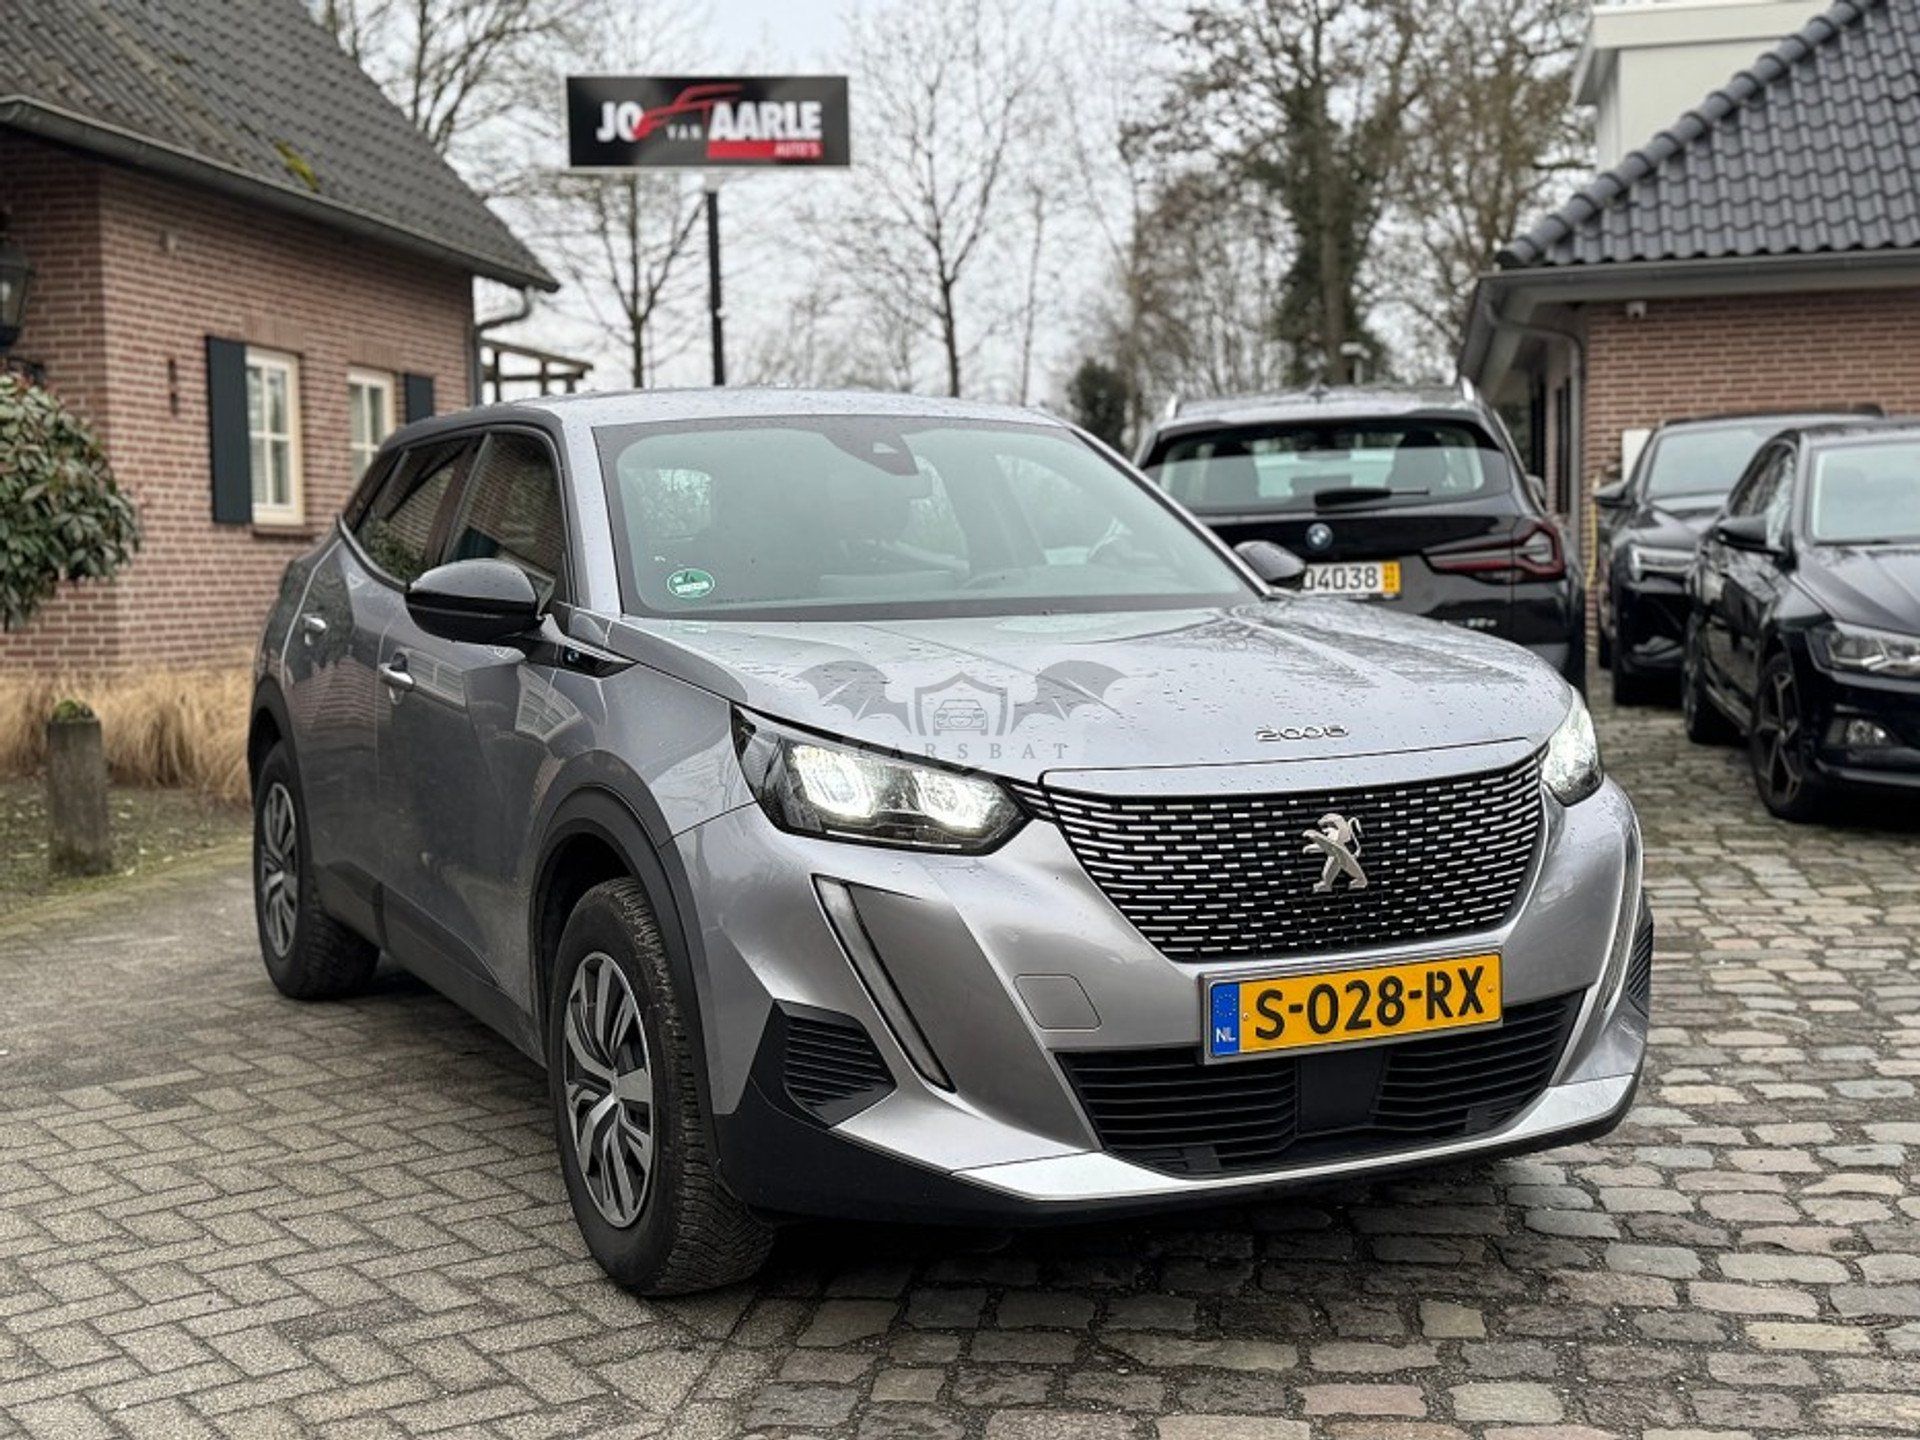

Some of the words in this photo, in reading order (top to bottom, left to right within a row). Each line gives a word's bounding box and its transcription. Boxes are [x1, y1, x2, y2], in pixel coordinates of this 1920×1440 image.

[709, 101, 822, 140] AARLE
[1255, 965, 1485, 1040] S-028-RX
[1216, 1027, 1237, 1043] NL
